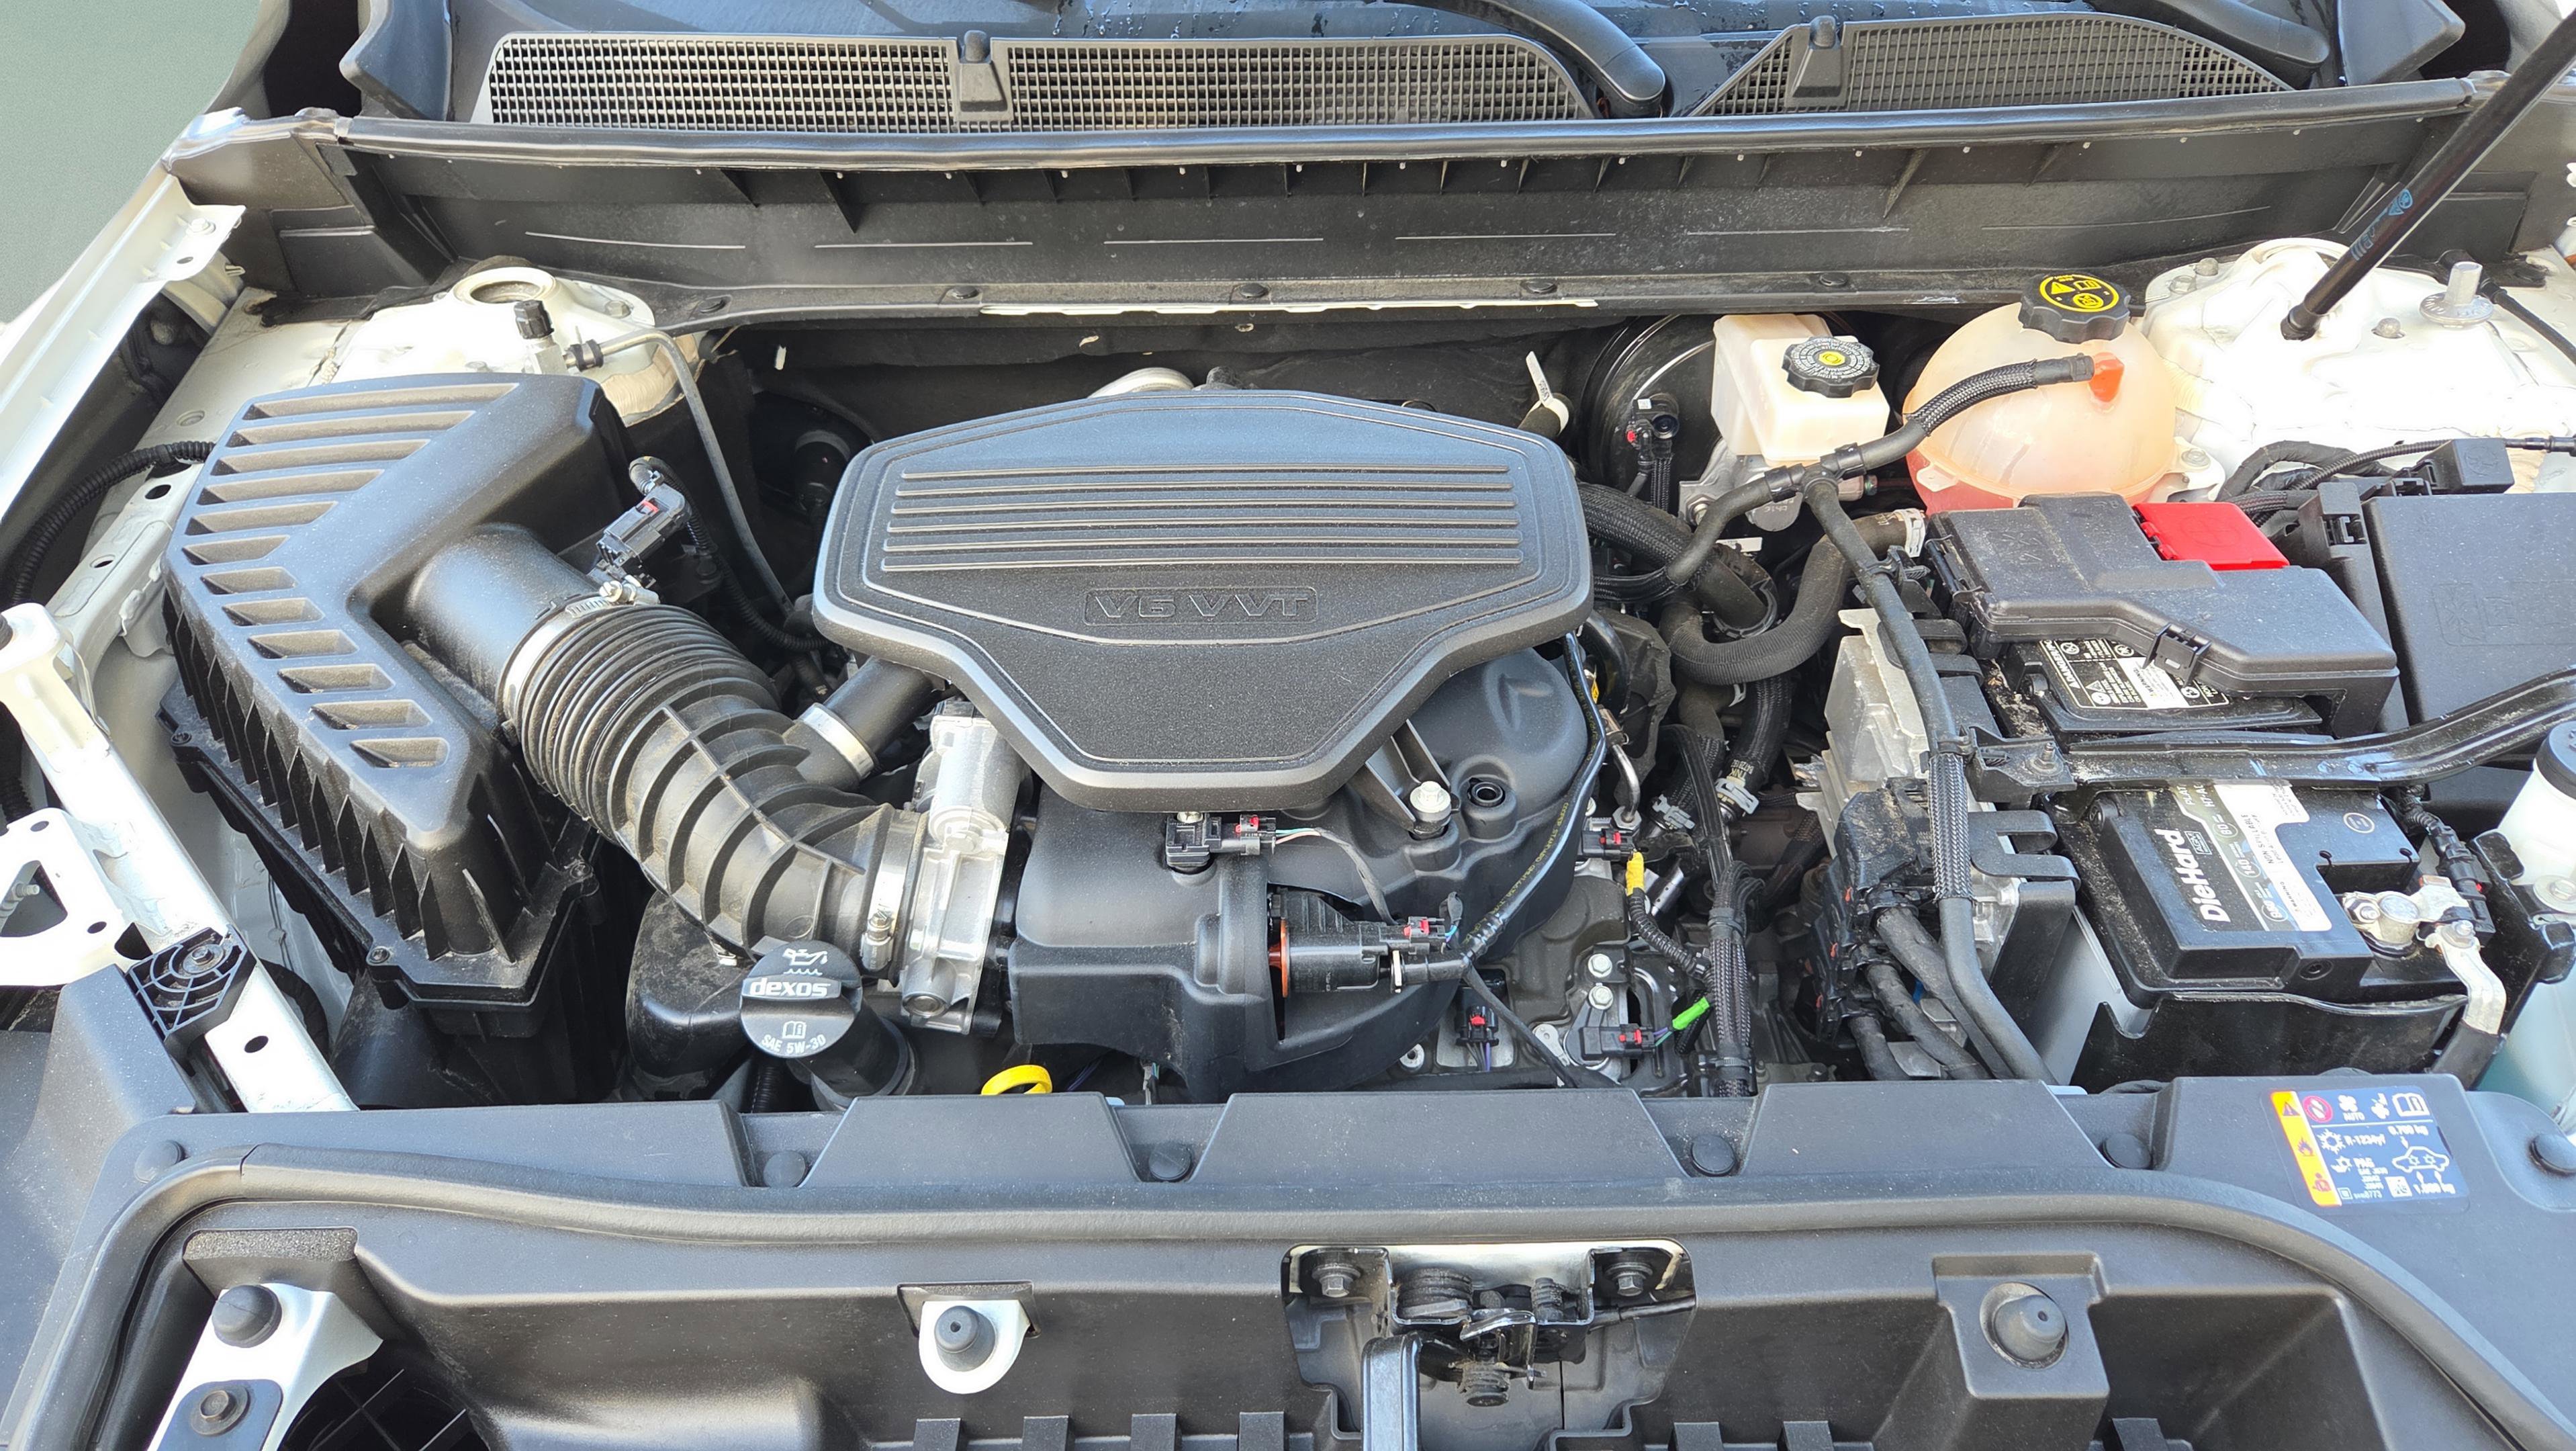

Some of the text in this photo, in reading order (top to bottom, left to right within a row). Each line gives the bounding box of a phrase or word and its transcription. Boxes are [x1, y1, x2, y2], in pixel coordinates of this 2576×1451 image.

[1095, 594, 1308, 618] V6 VVT
[2188, 833, 2205, 854] AGM
[2153, 828, 2231, 923] DieHard
[749, 978, 830, 997] dexos
[762, 1034, 826, 1054] SAE 5W-30
[2343, 1112, 2365, 1121] AUTO
